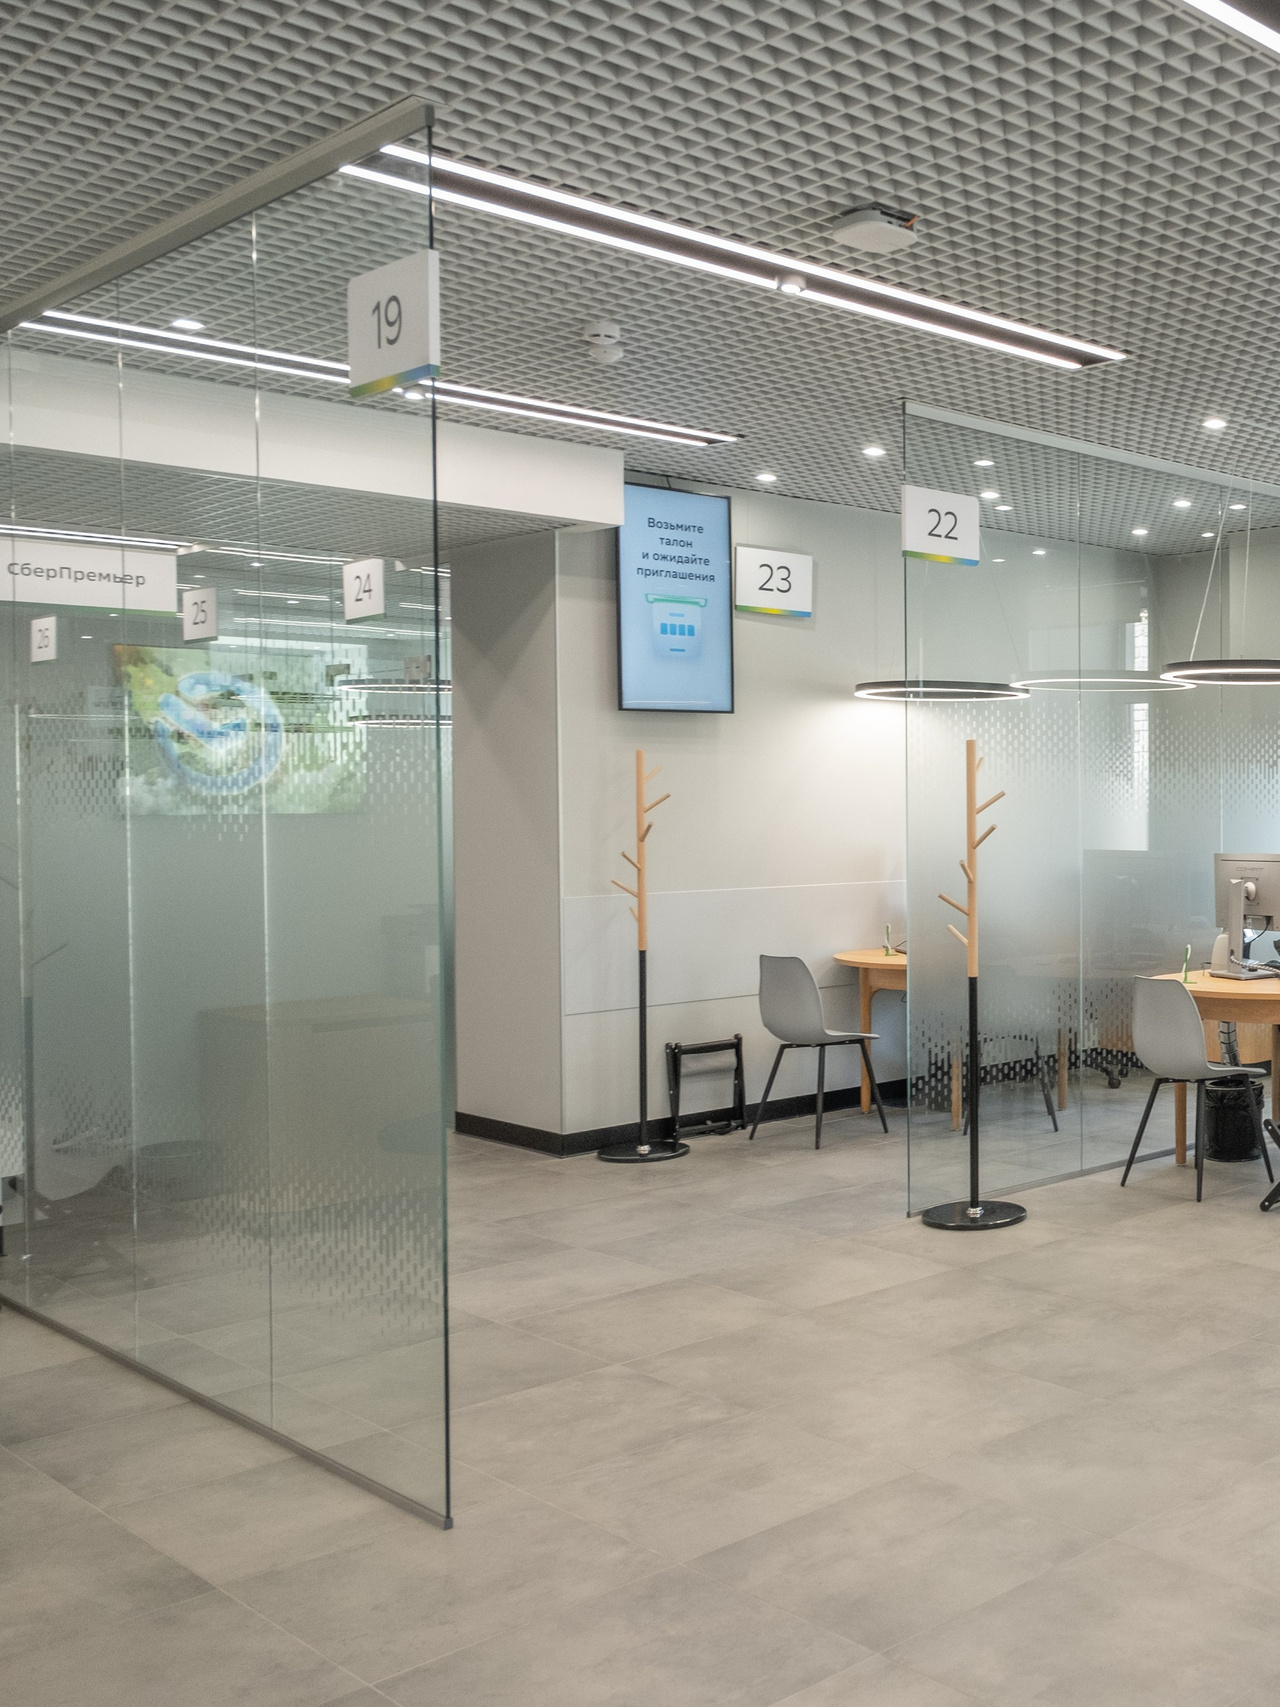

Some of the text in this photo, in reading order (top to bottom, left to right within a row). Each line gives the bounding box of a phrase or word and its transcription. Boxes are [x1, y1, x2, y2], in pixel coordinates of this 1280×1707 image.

[372, 295, 402, 349] 19
[647, 517, 704, 534] Возьмите
[927, 508, 958, 541] 22
[659, 537, 693, 548] талон
[641, 552, 710, 566] и ожидайте
[7, 562, 146, 588] СберПремьер
[354, 573, 373, 602] 24
[636, 567, 716, 583] приглашения
[758, 563, 792, 593] 23
[192, 600, 208, 626] 25
